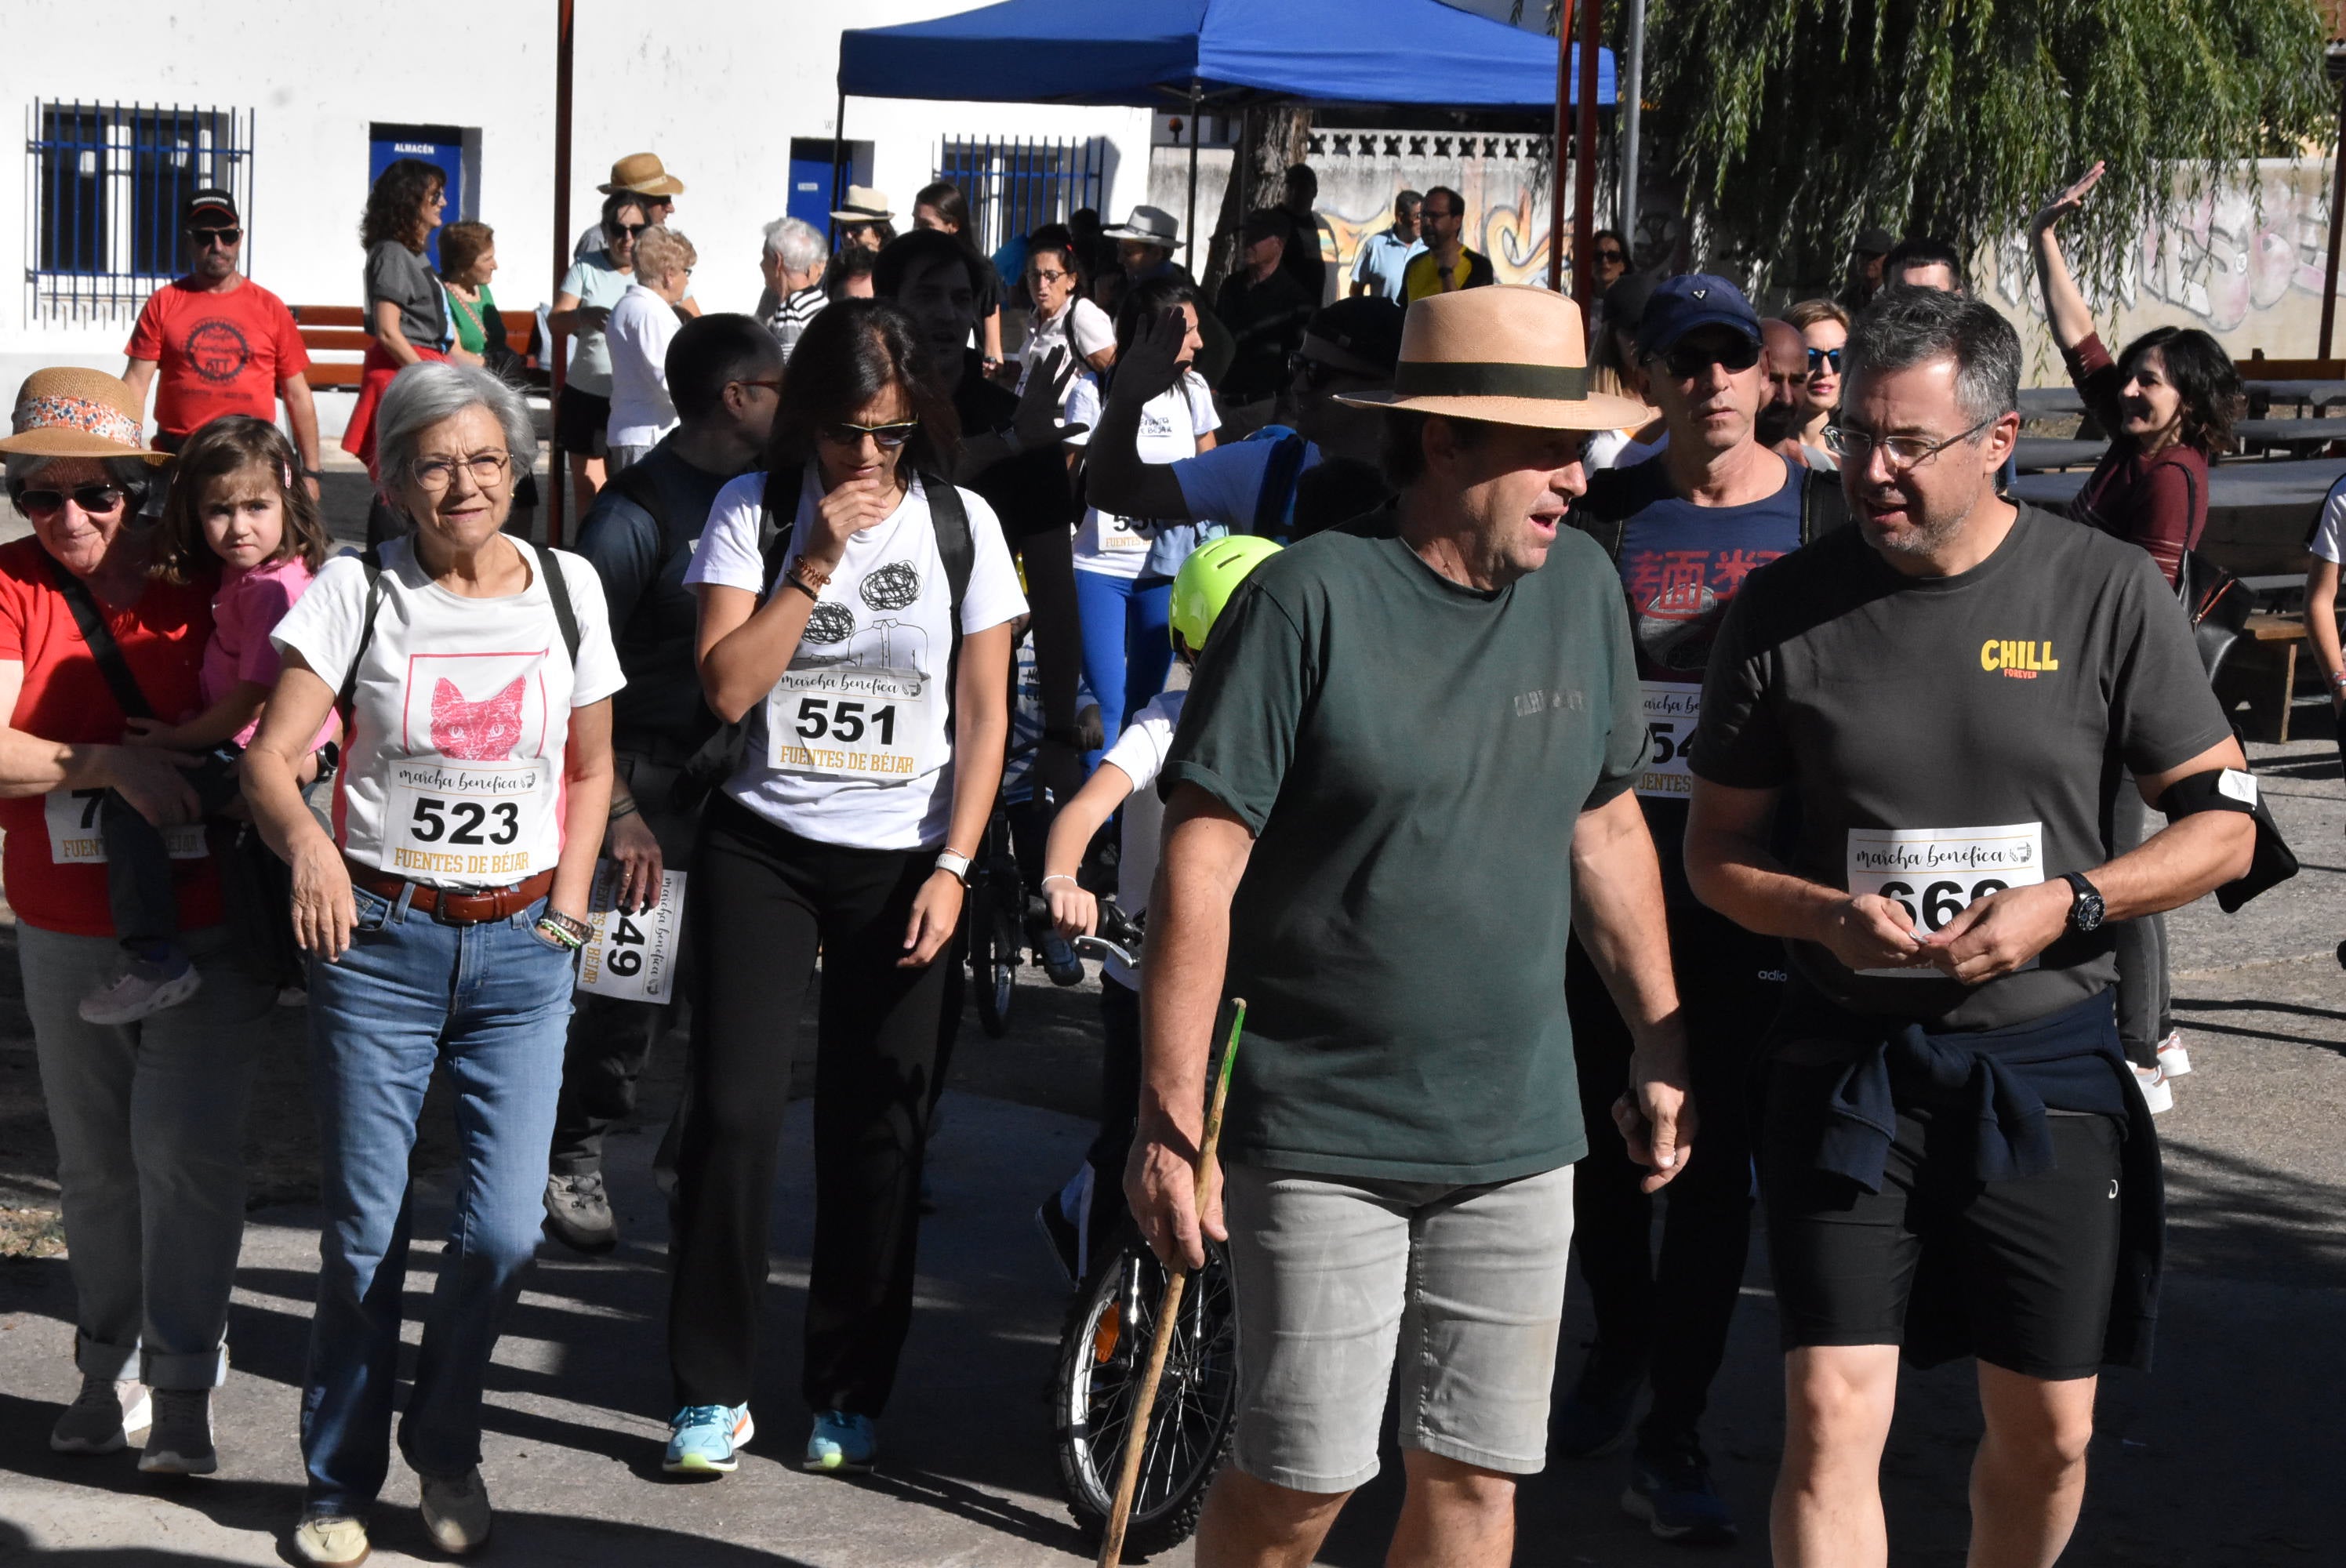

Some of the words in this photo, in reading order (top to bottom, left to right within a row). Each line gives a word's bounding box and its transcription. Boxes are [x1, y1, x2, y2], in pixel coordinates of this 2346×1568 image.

[394, 143, 434, 154] ALMACÉN
[1113, 515, 1158, 532] 55
[1106, 537, 1141, 547] FUENTES
[1981, 640, 2058, 671] CHILL
[781, 673, 836, 691] marcha
[2003, 668, 2037, 680] FOREVER
[1643, 695, 1682, 713] archa
[795, 698, 895, 745] 551
[779, 746, 844, 768] FUENTES
[847, 752, 866, 771] DE
[870, 752, 914, 773] BÉJAR
[399, 769, 456, 789] marcha
[1638, 772, 1693, 792] UENTES
[410, 797, 519, 845] 523
[63, 838, 101, 858] FUEN
[1856, 845, 1922, 869] marcha
[394, 848, 463, 873] FUENTES
[467, 855, 488, 874] DE
[492, 851, 529, 874] BÉJAR
[656, 877, 673, 924] marcha
[583, 946, 603, 985] BÉJAR
